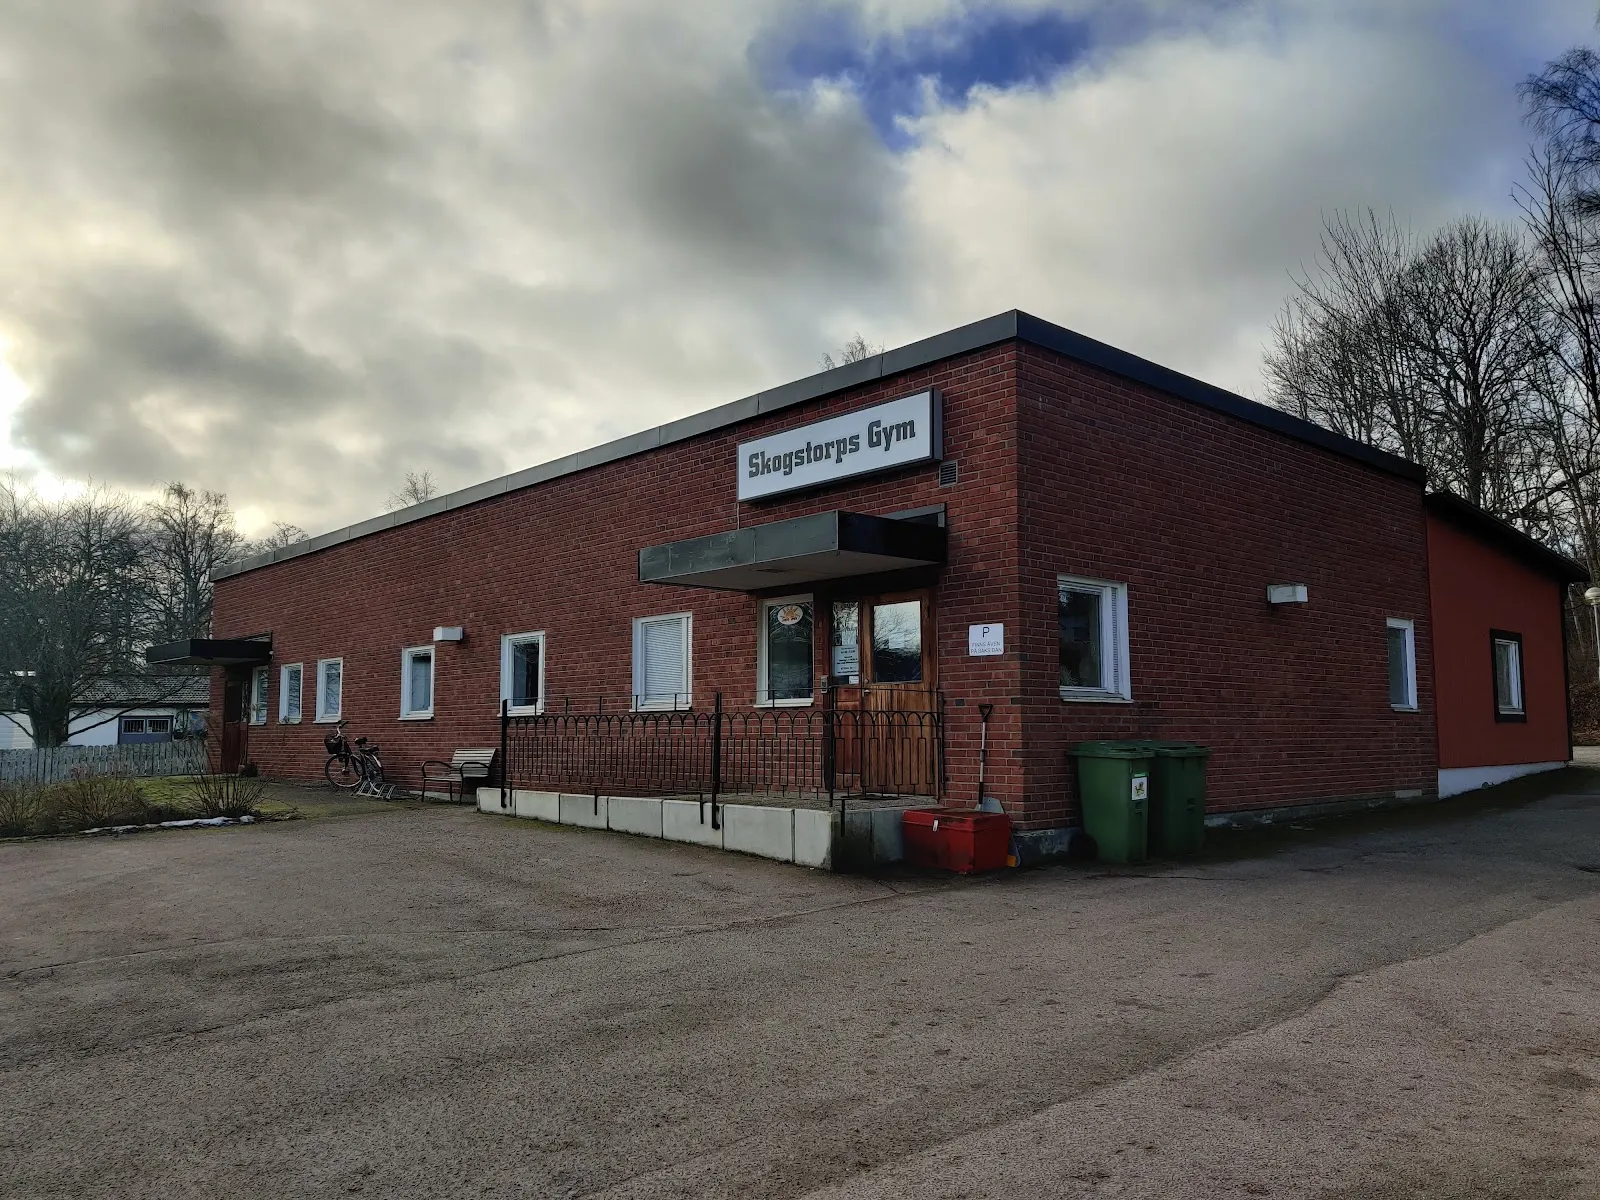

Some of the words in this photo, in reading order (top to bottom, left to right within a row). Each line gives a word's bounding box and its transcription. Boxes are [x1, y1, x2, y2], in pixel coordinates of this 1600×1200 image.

[749, 434, 860, 478] Skogstorps
[867, 419, 916, 452] Gym
[983, 627, 989, 638] P
